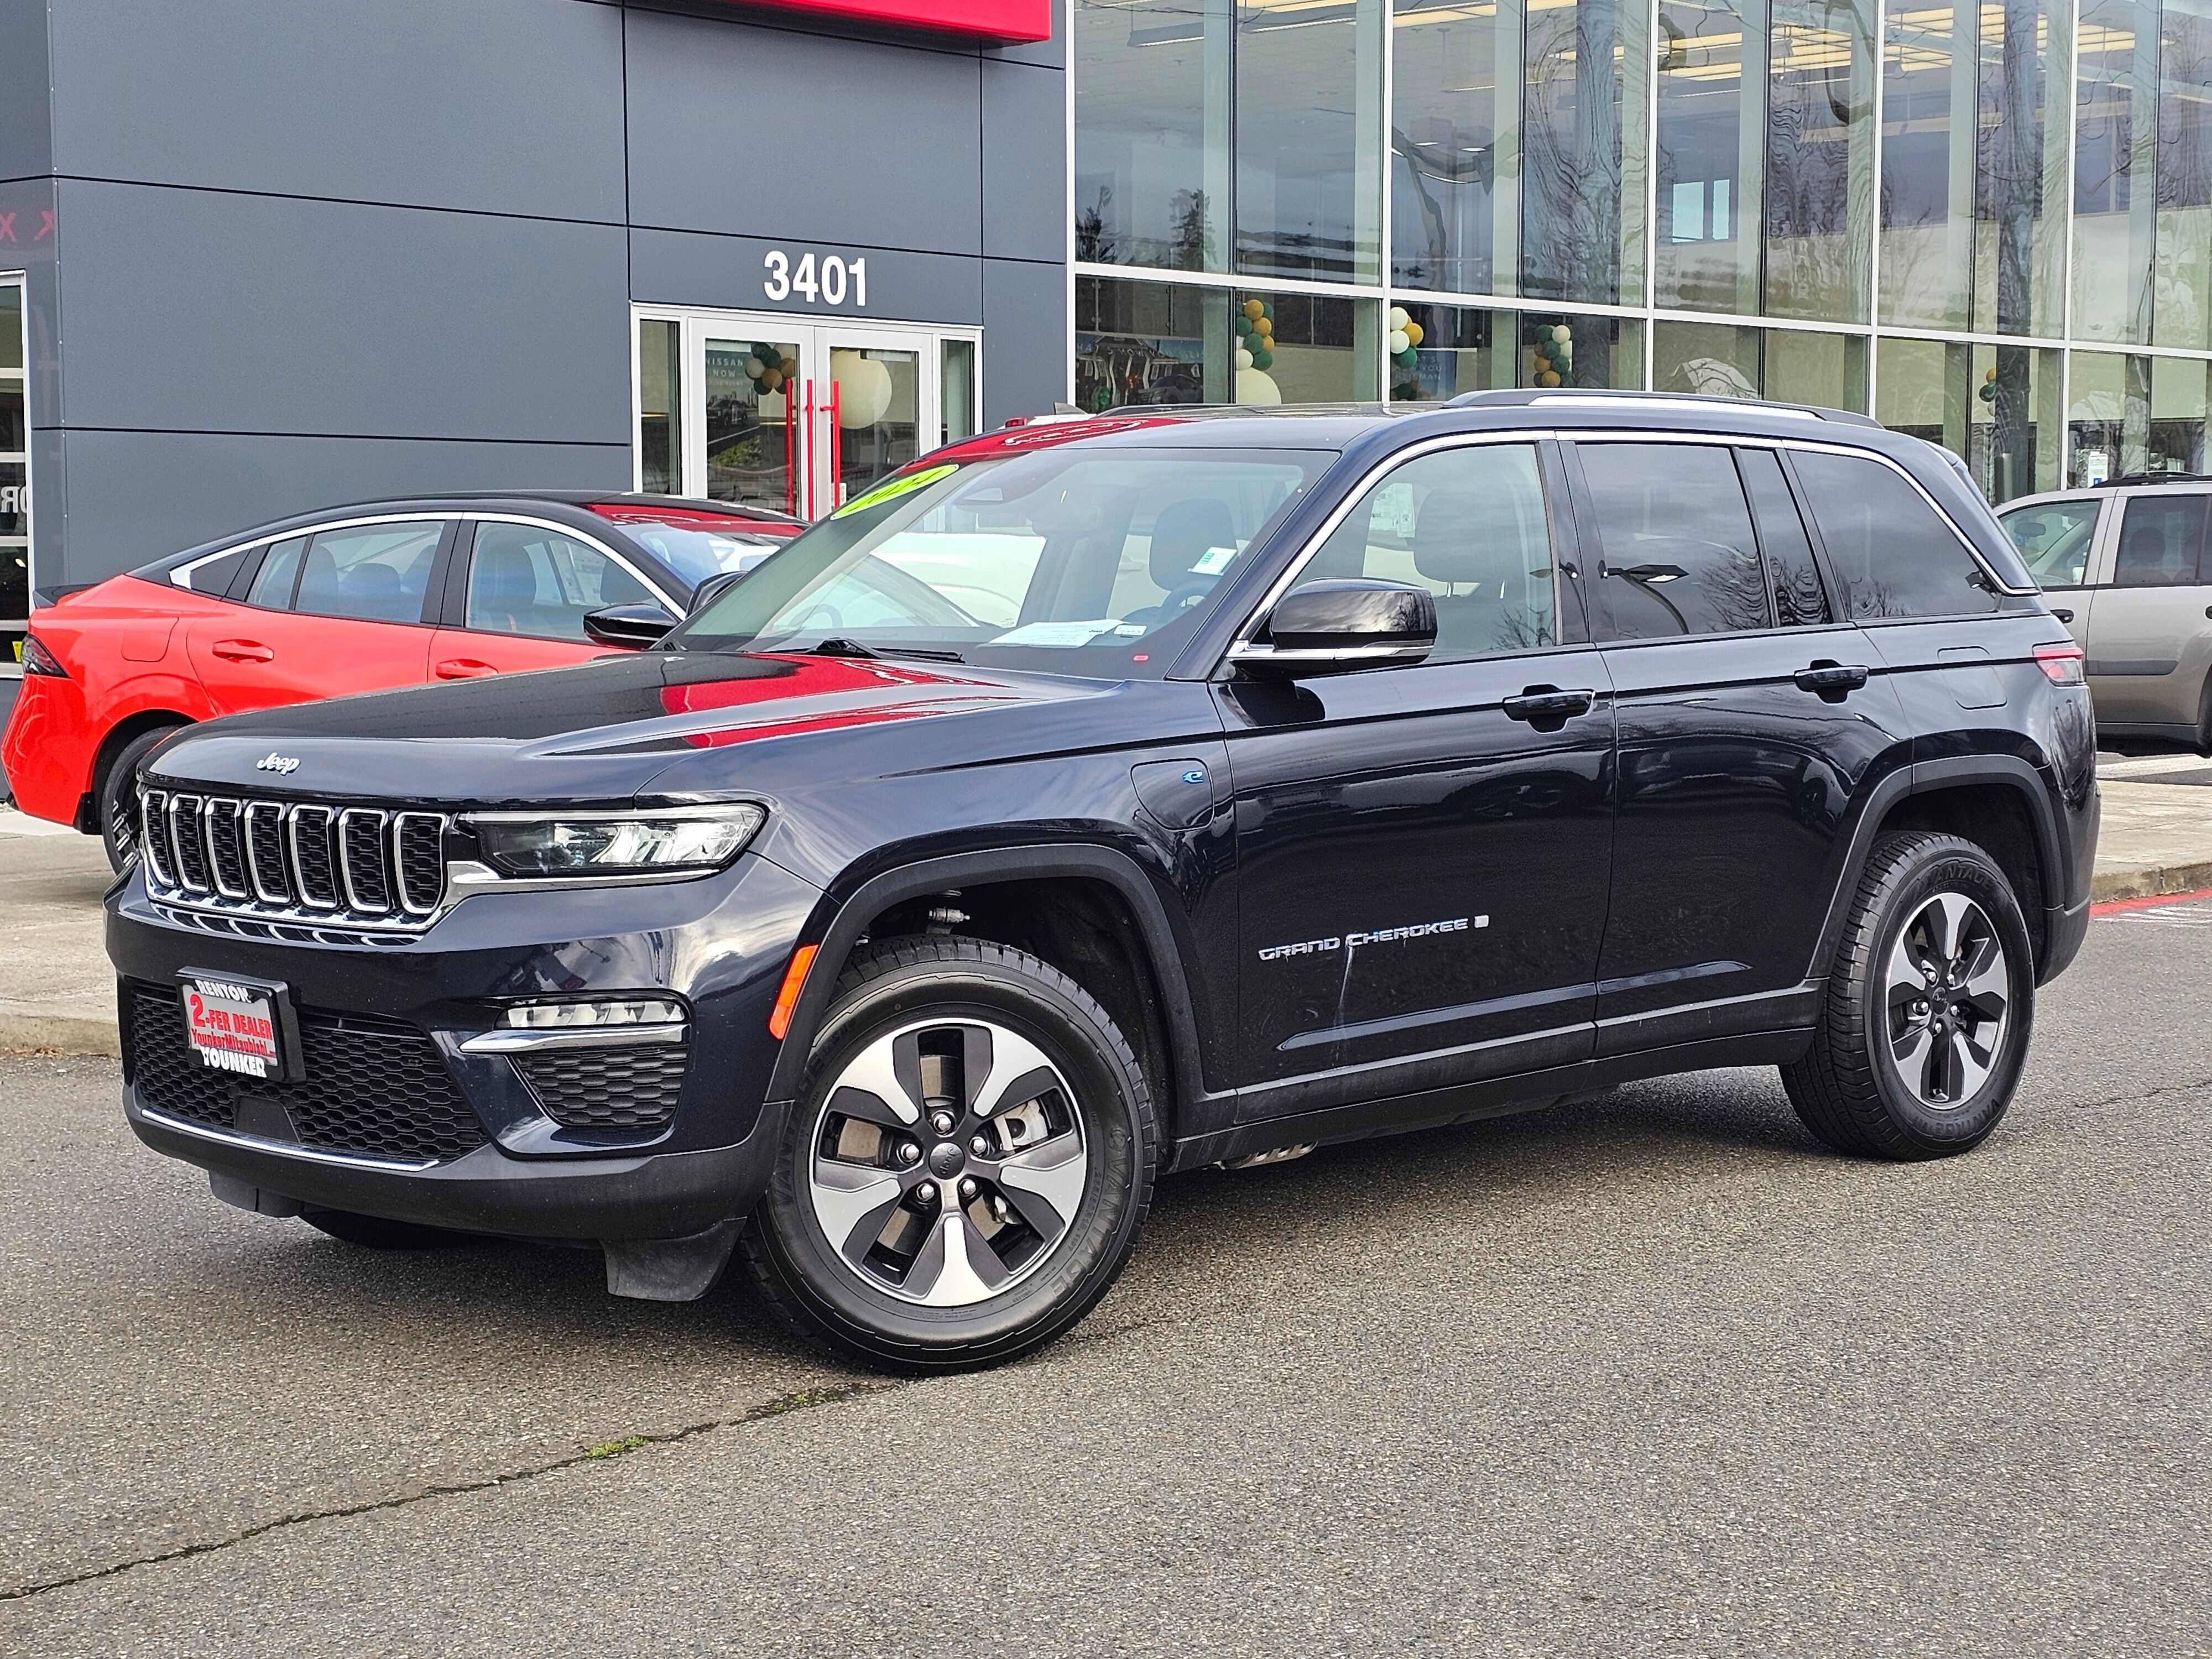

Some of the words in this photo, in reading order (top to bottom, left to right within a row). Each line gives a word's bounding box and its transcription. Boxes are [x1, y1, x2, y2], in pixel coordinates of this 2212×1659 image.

[764, 251, 866, 306] 3401
[706, 357, 743, 367] NISSAN
[713, 369, 735, 377] NOW
[256, 752, 301, 776] Jeep
[1259, 937, 1340, 961] GRAND
[1346, 918, 1468, 947] CHEROKEE
[195, 979, 252, 1003] RENTON
[190, 994, 231, 1032] 2-FER
[232, 1014, 273, 1040] DEALER
[199, 1046, 267, 1078] YOUNKER
[1051, 1156, 1127, 1299] VANTAGE
